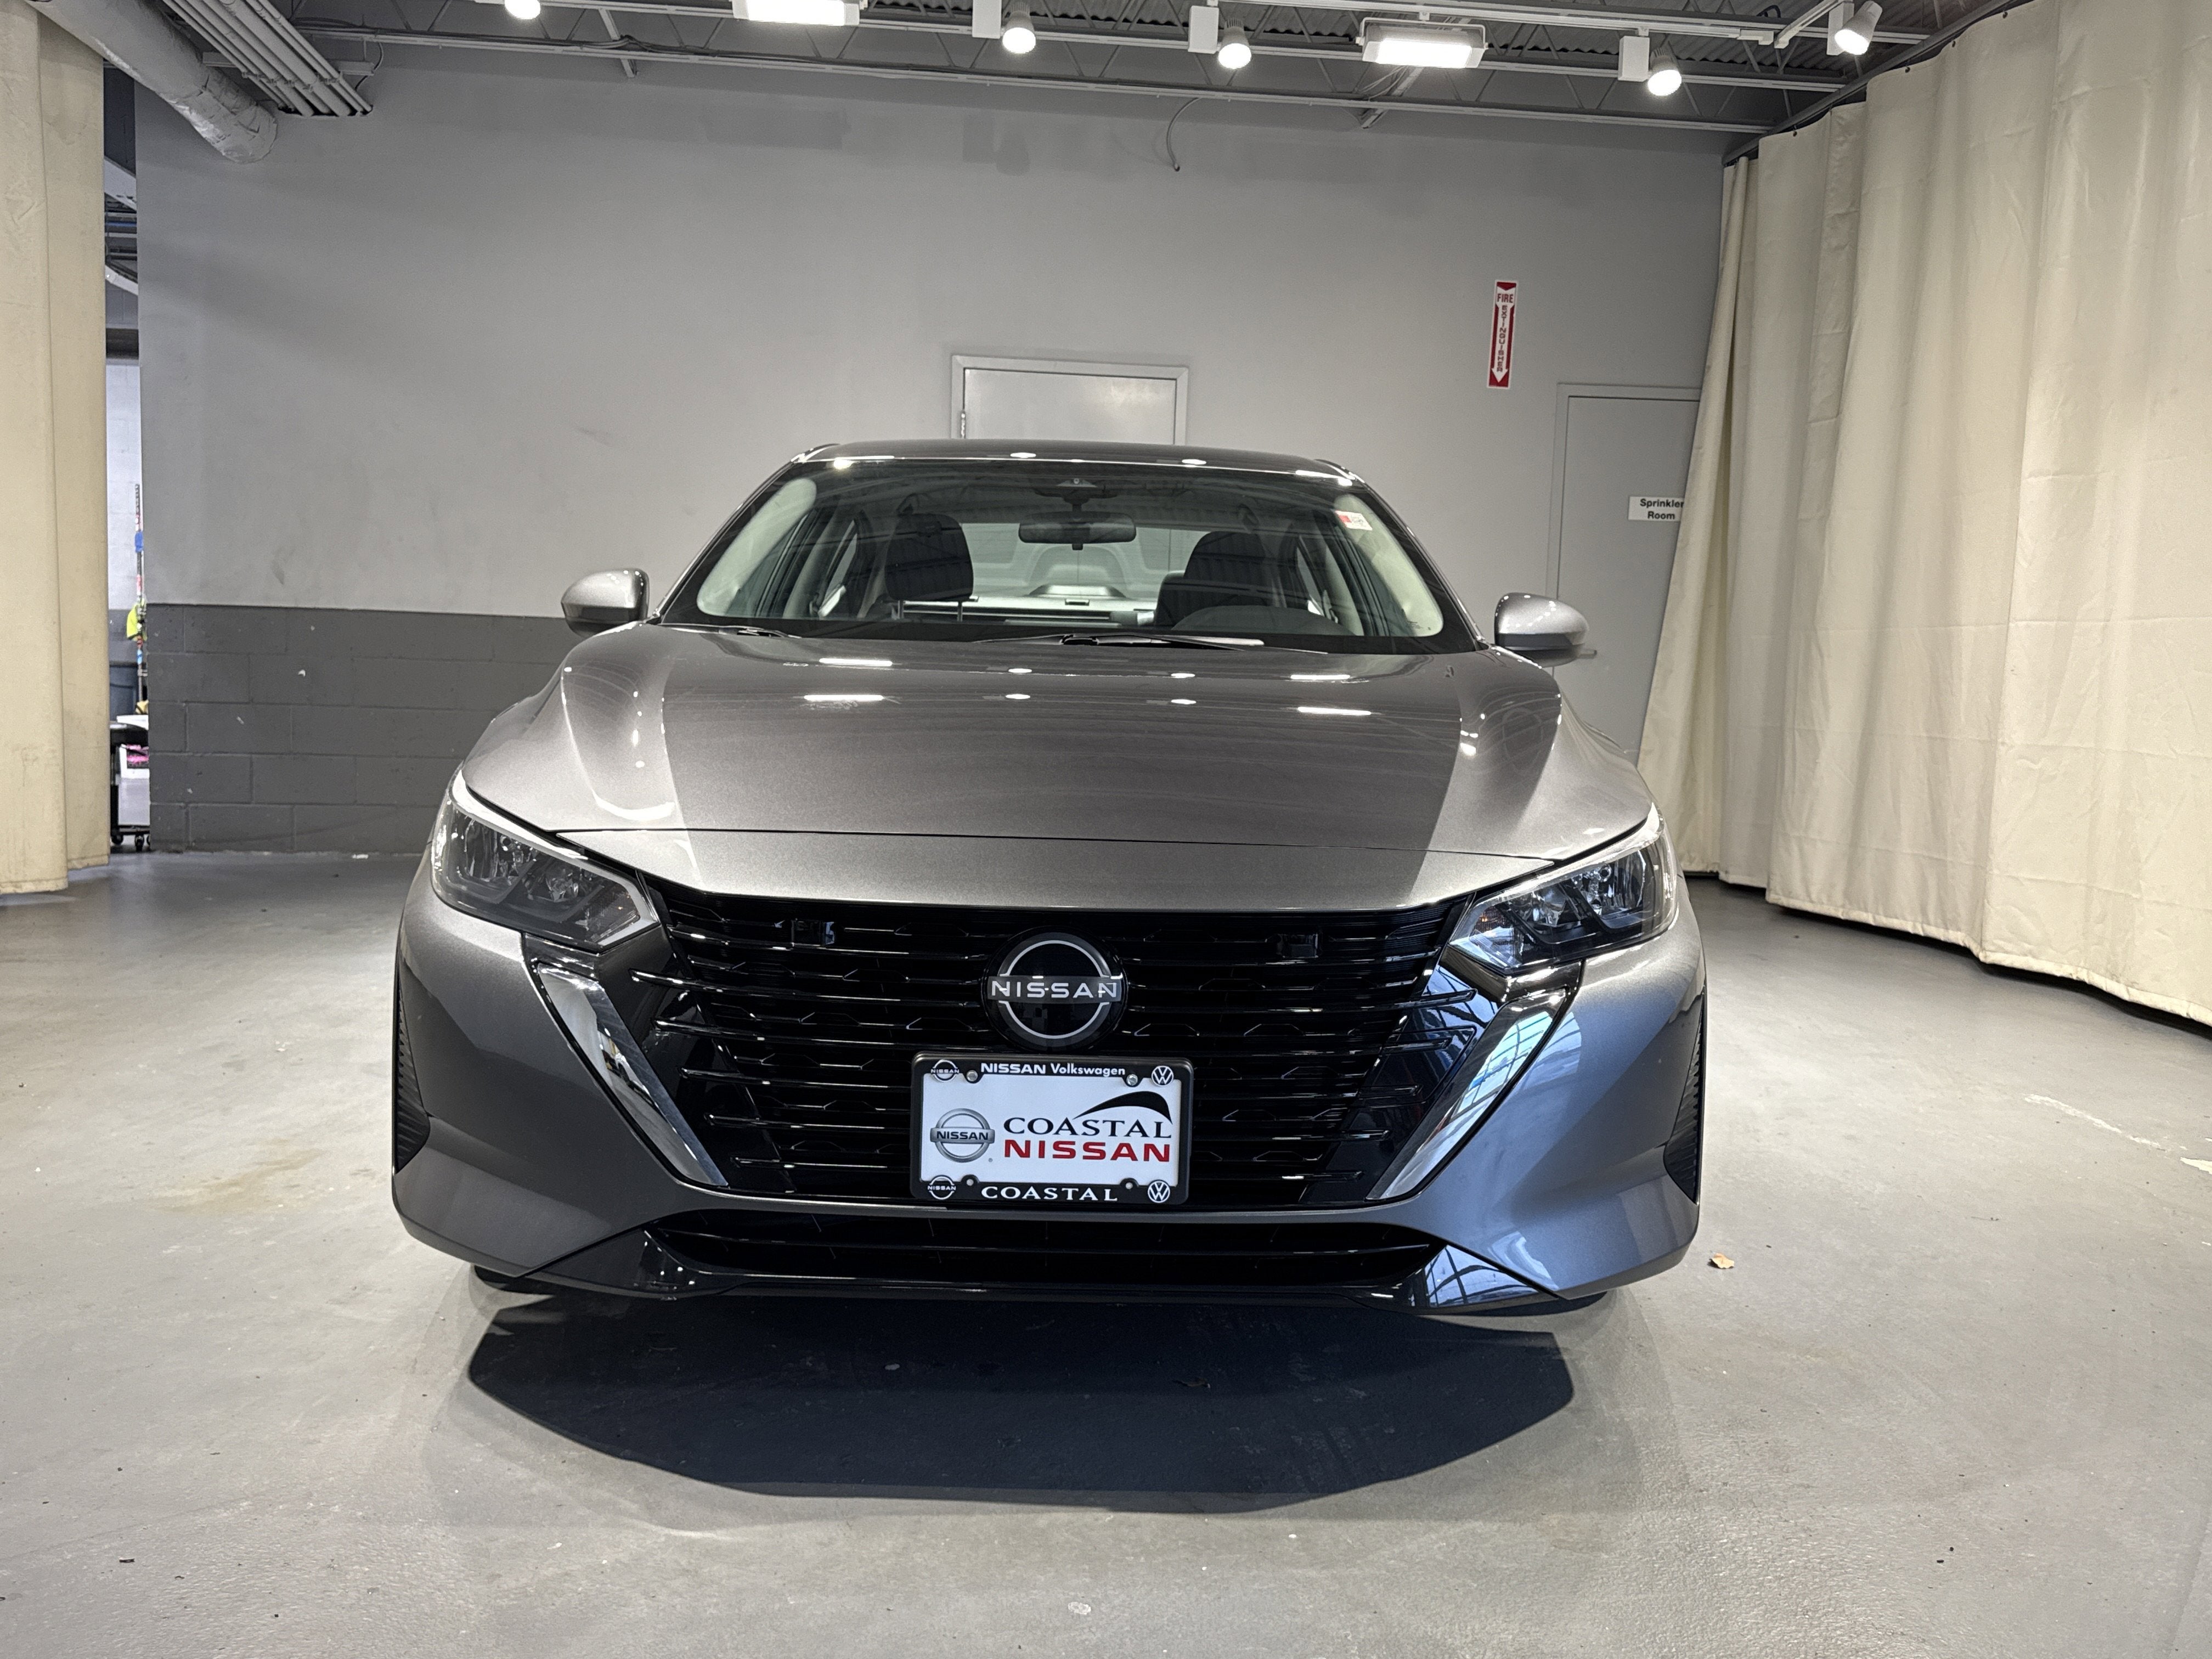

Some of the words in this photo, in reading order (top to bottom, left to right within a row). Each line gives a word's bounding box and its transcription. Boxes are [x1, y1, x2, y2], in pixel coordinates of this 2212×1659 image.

[1497, 294, 1514, 303] FIRE
[1497, 305, 1508, 372] EXTINGUISHER
[1640, 498, 1684, 508] Sprinkler
[1647, 511, 1675, 520] Room
[991, 980, 1118, 999] NISSAN
[981, 1063, 1046, 1074] NISSAN
[1050, 1062, 1126, 1077] Volkswagen
[1003, 1117, 1172, 1138] COASTAL
[936, 1131, 989, 1141] NISSAN
[1004, 1139, 1170, 1162] NISSAN
[981, 1186, 1118, 1201] COASTAL
